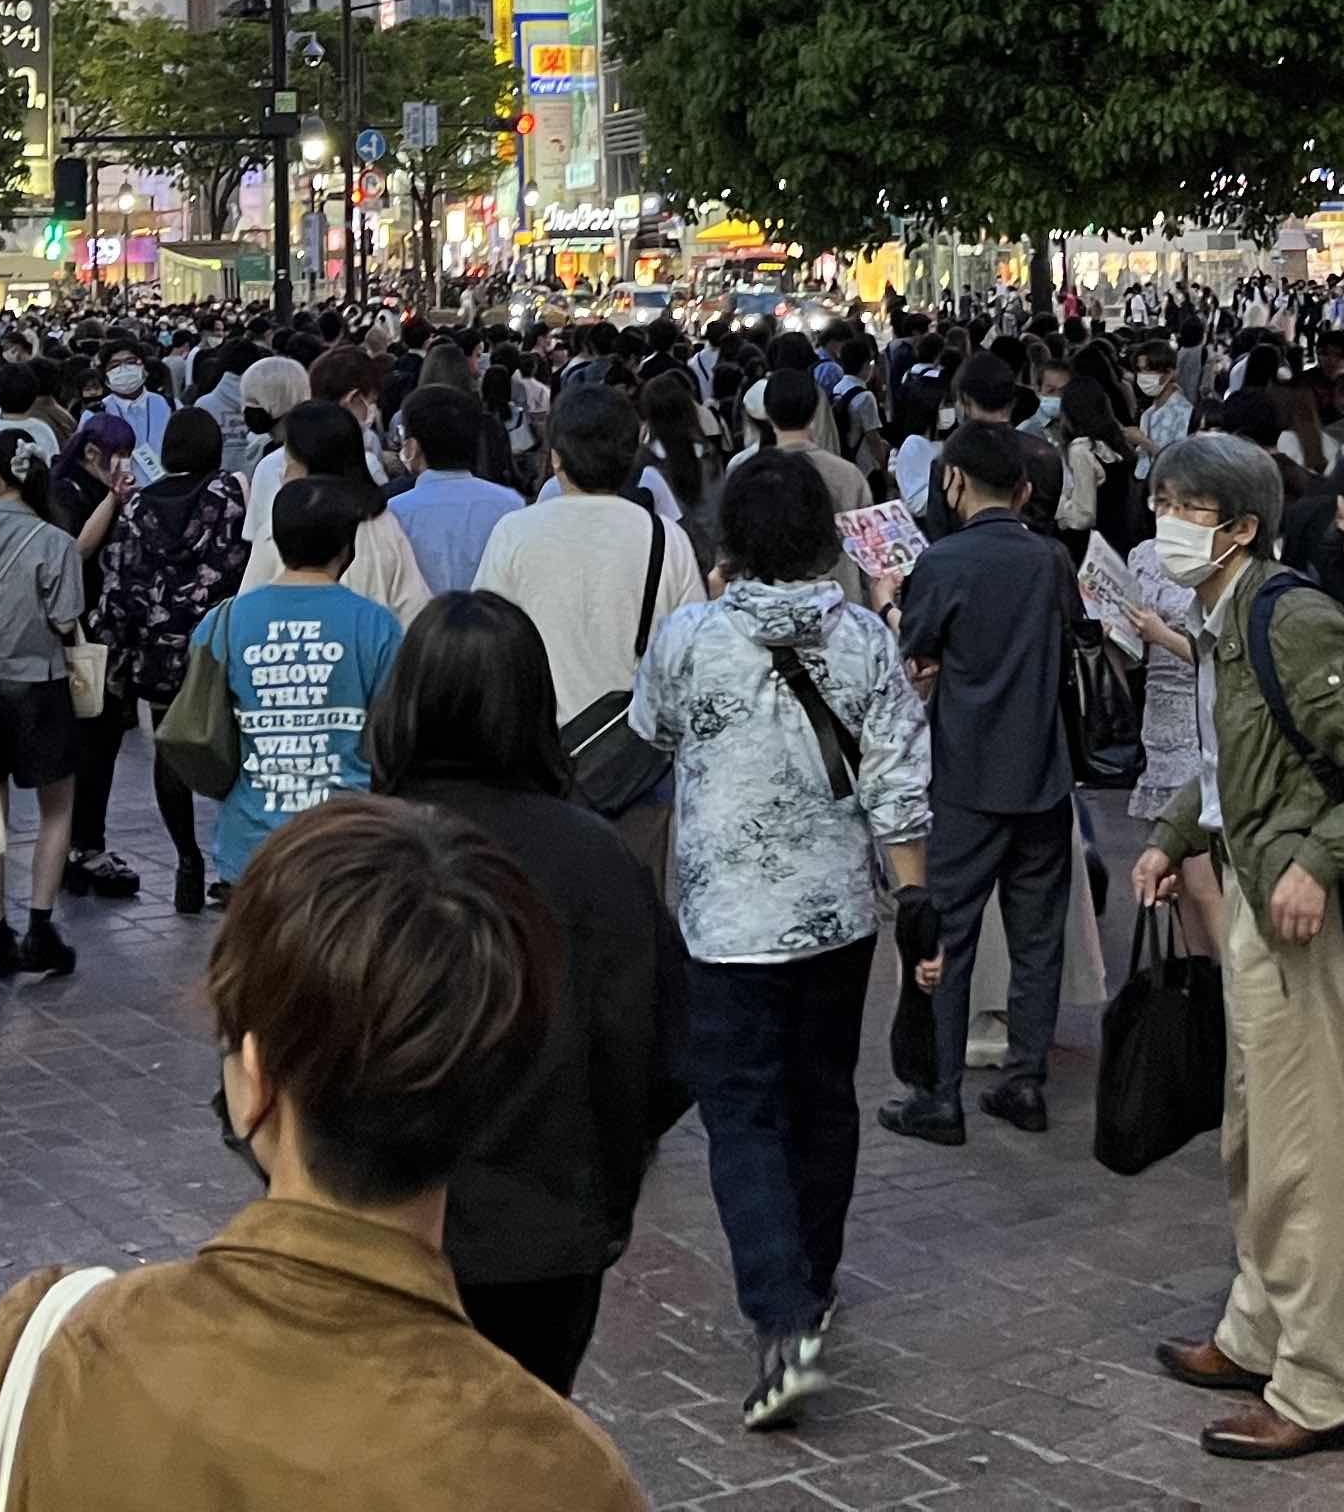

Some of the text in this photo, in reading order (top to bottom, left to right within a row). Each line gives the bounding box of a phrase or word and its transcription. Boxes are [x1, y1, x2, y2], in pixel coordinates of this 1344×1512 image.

[267, 620, 322, 641] I'VE
[243, 641, 345, 666] GOT TO
[252, 663, 334, 687] SHOW
[256, 686, 328, 708] THAT
[254, 733, 329, 756] WHAT
[243, 752, 342, 776] A GREAT
[264, 791, 277, 812] I
